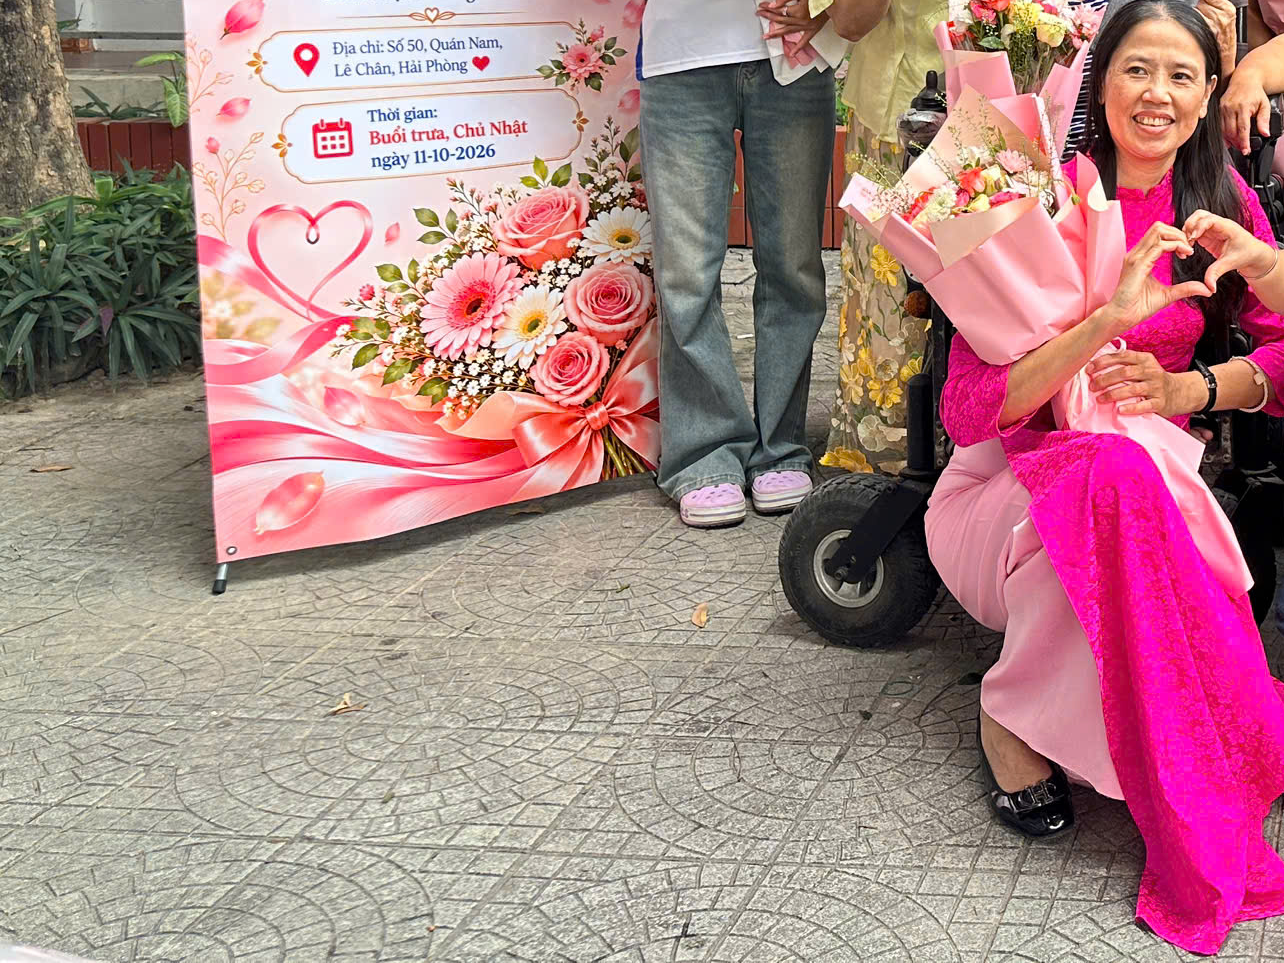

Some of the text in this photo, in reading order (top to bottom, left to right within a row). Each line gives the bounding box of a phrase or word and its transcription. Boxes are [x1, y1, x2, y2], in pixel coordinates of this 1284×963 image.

[333, 36, 503, 57] Địa chỉ: Số 50, Quán Nam,
[334, 58, 468, 77] Lê Chân, Hải Phòng
[367, 107, 438, 123] Thời gian:
[369, 119, 529, 145] Buổi trưa, Chủ Nhật
[371, 143, 496, 171] ngày 11-10-2026
